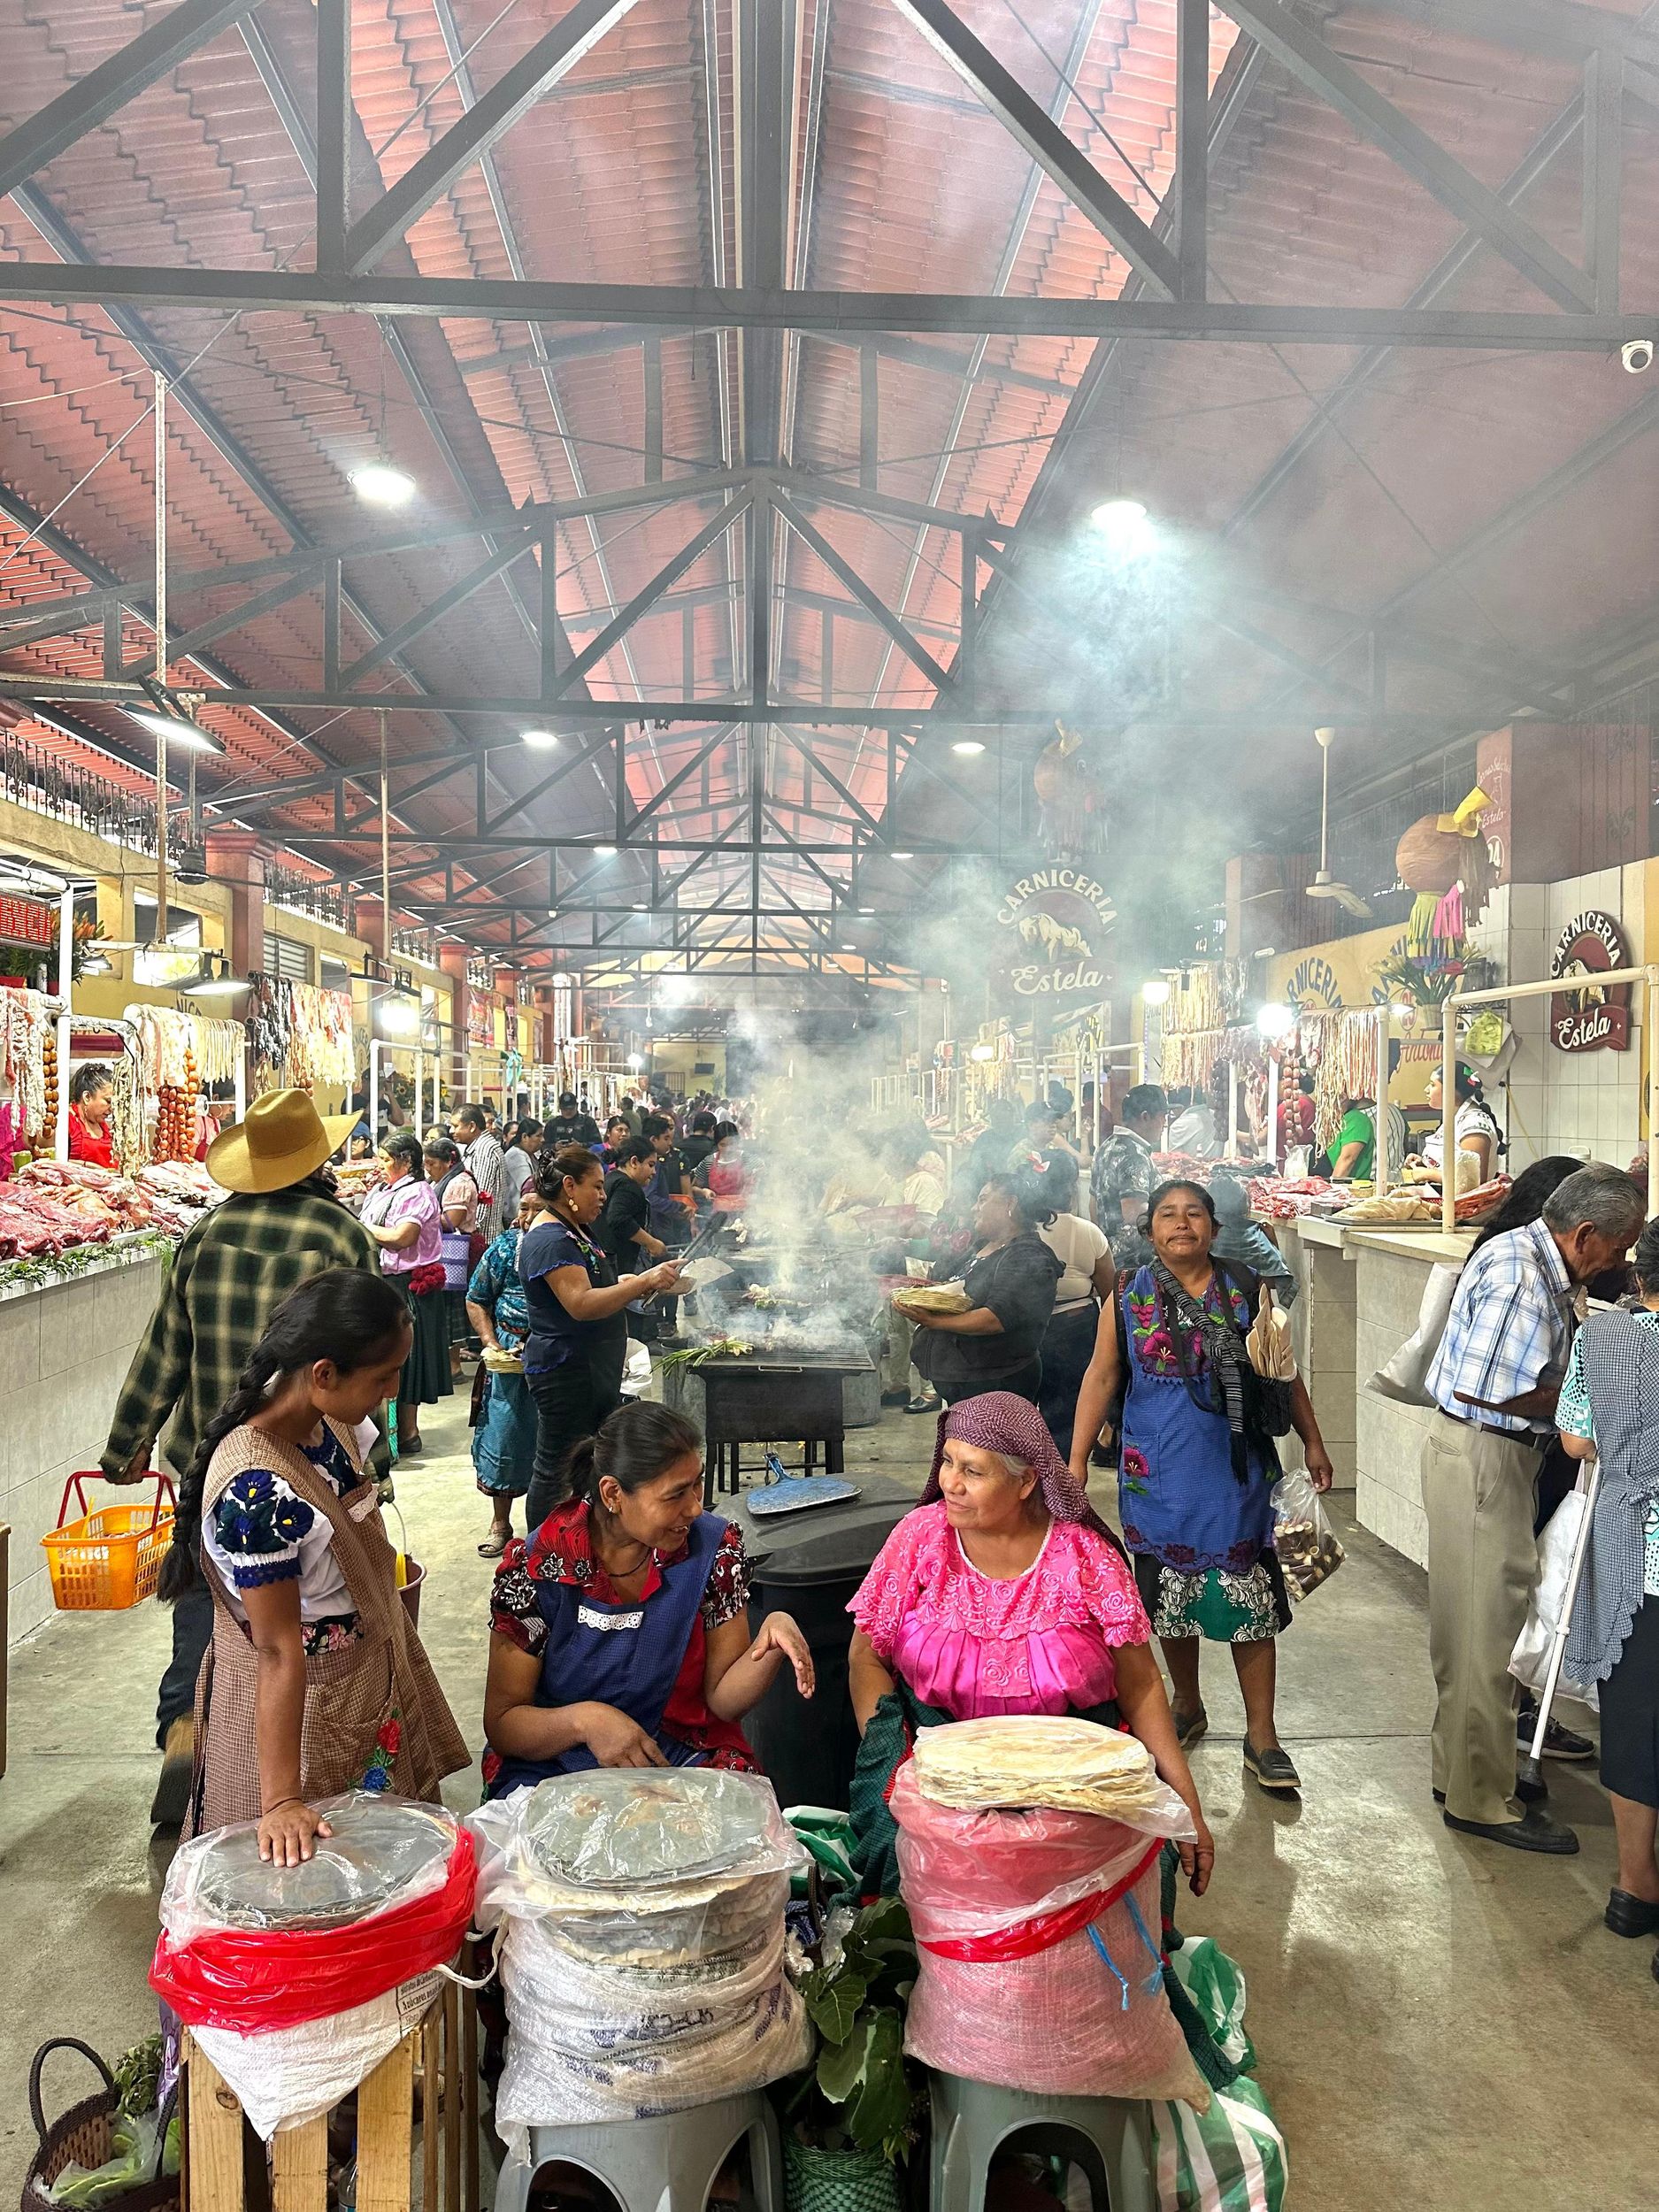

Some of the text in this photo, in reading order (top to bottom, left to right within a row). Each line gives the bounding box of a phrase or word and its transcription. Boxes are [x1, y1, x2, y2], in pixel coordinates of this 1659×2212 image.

[997, 869, 1118, 926] CARNICERIA
[1550, 911, 1621, 977] CARNICERIA
[1010, 961, 1103, 995] Estela
[1286, 957, 1342, 1009] RNICERIA
[1557, 1007, 1611, 1049] Estela
